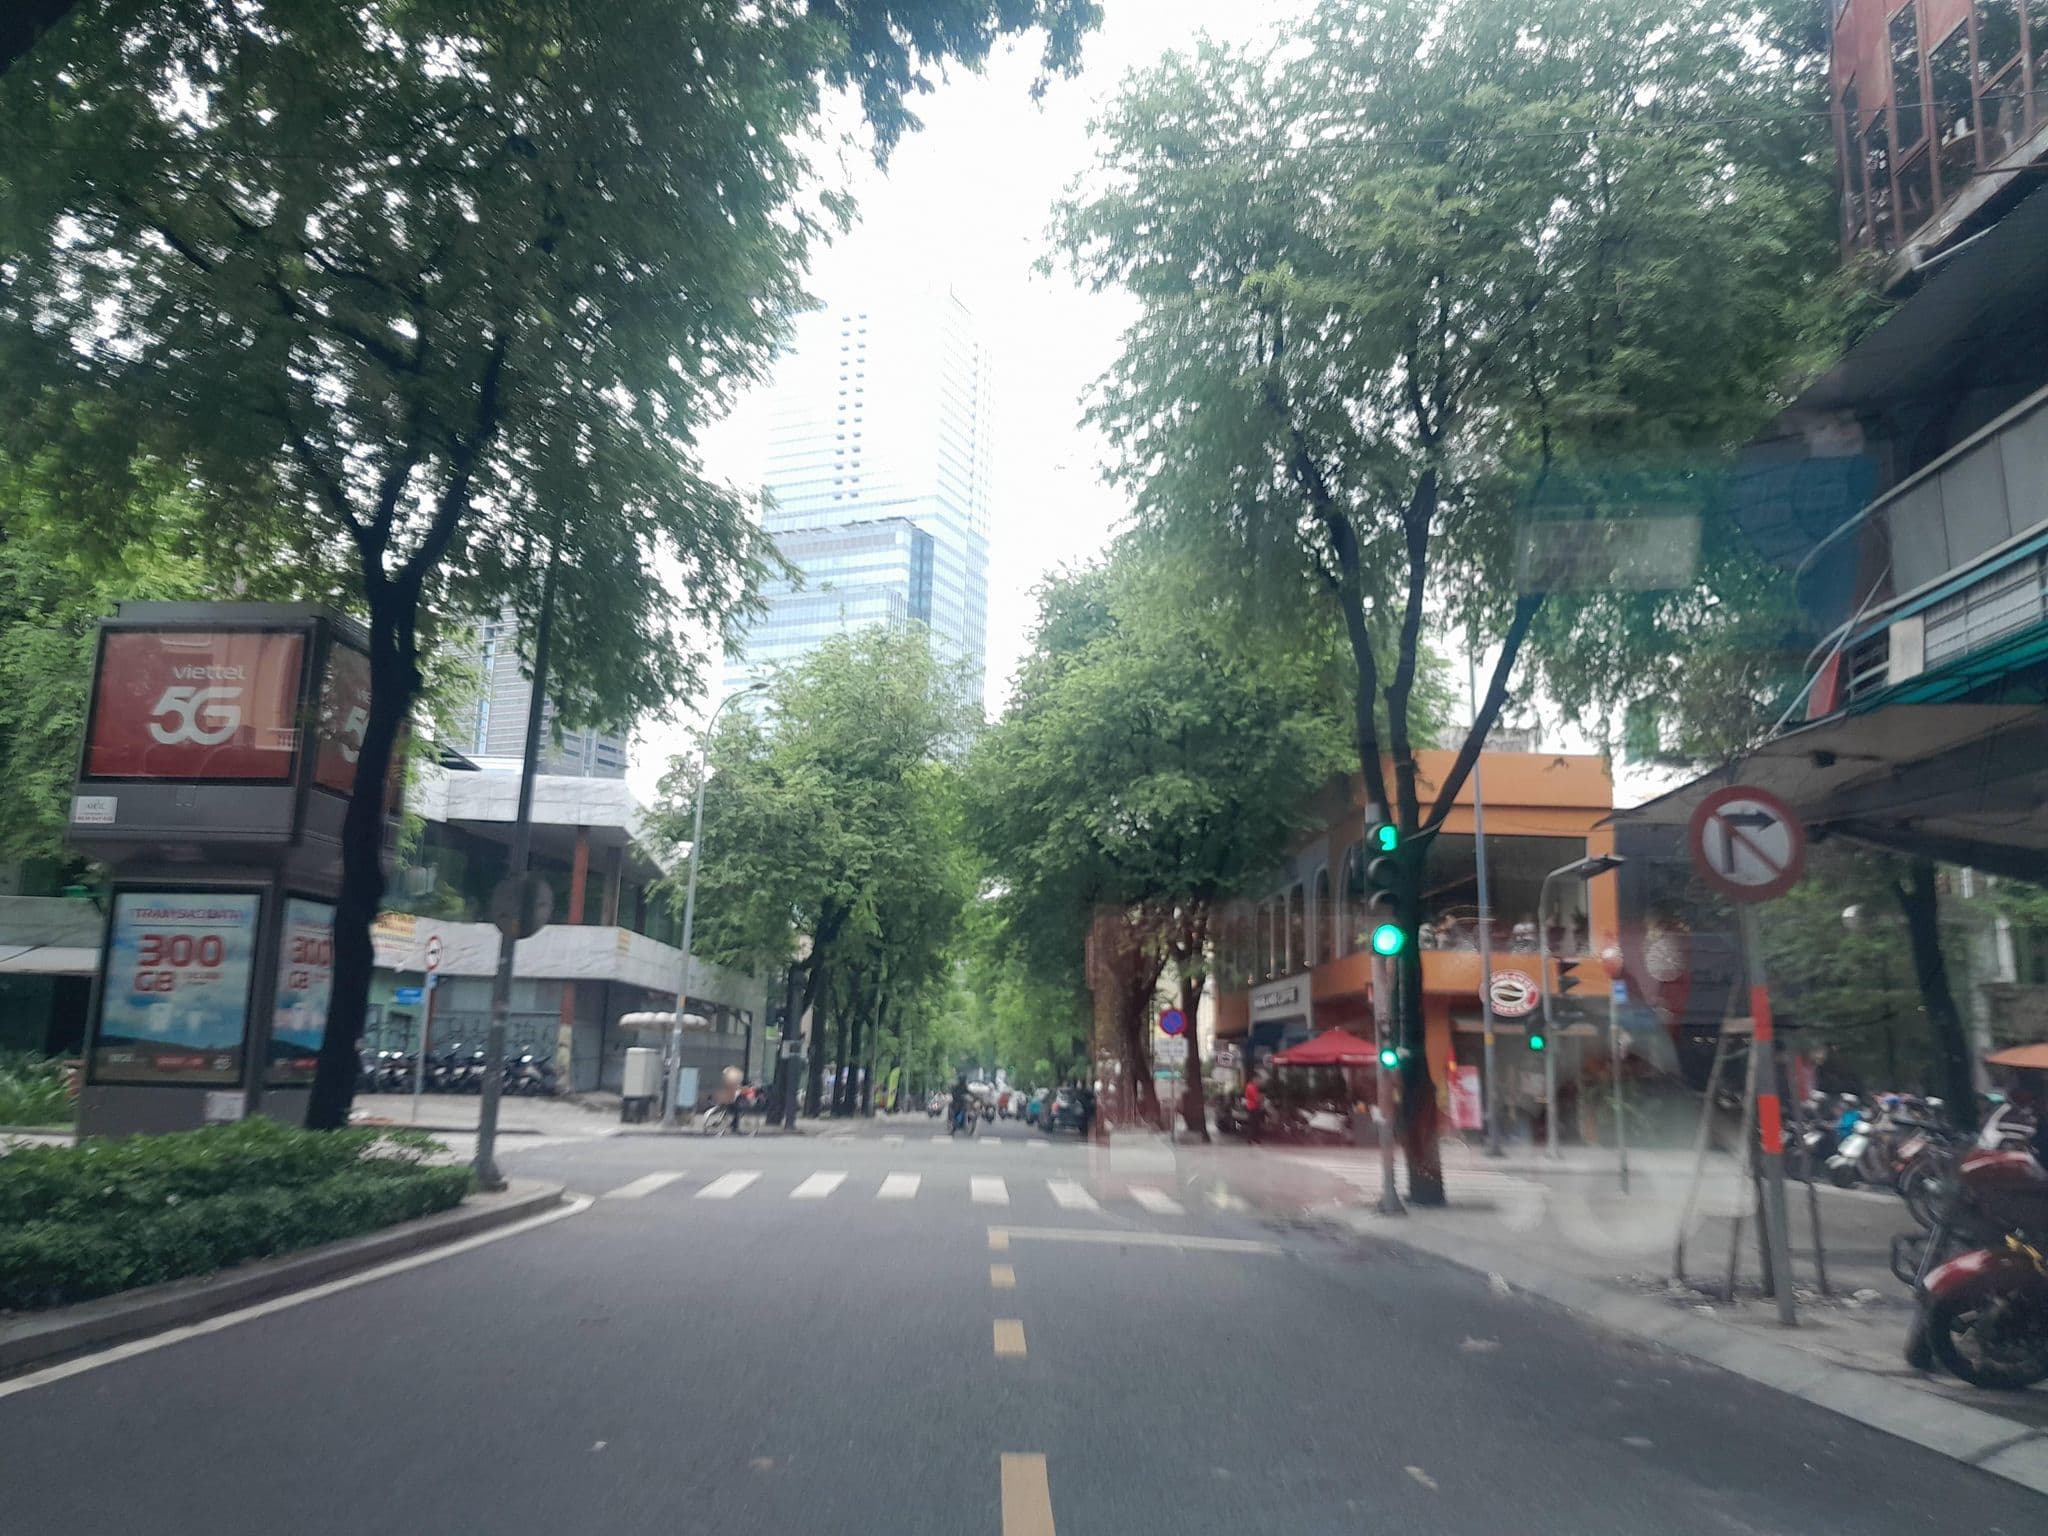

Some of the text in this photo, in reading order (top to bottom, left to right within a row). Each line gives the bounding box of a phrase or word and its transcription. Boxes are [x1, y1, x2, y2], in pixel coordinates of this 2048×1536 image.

[173, 664, 246, 680] viettel
[149, 686, 243, 745] 5G
[138, 934, 224, 967] 300
[292, 936, 334, 967] 300
[135, 971, 175, 992] GB
